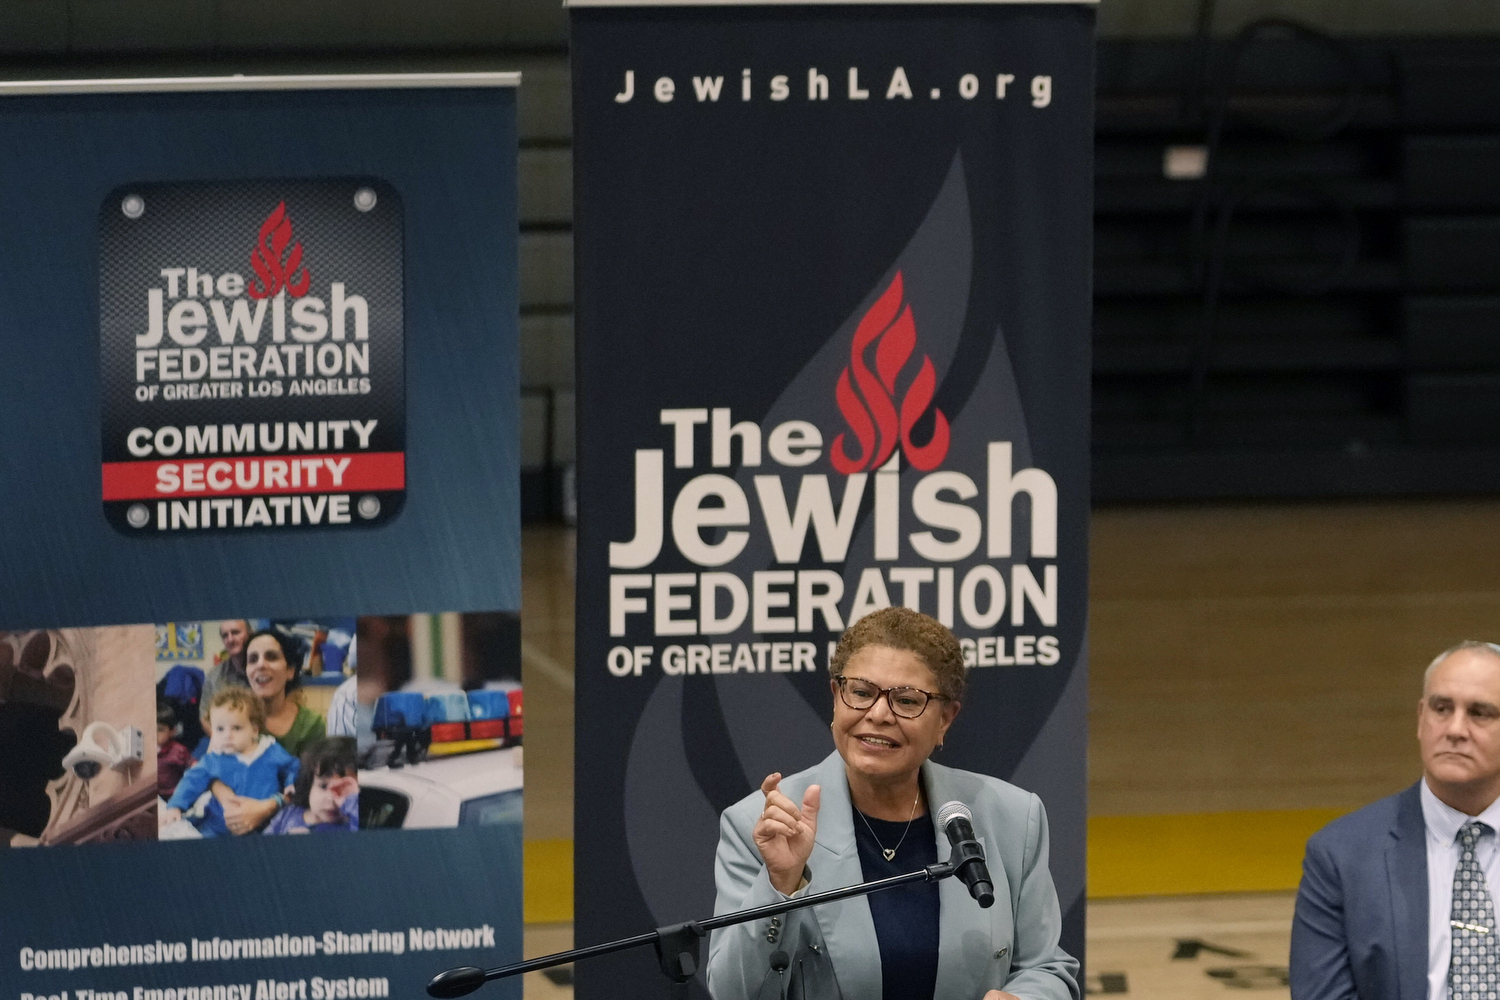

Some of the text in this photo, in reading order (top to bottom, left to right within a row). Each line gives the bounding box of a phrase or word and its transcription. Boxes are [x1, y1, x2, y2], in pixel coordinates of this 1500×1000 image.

[615, 67, 1052, 107] JewishLA.org
[161, 268, 245, 298] The
[136, 282, 368, 348] Jewish
[136, 343, 369, 381] FEDERATION
[135, 377, 371, 402] OF GREATER LOS ANGELES
[127, 420, 378, 456] COMMUNITY
[660, 407, 823, 467] The
[156, 458, 351, 492] SECURITY
[158, 495, 351, 530] INITIATIVE
[609, 441, 1058, 569] Jewish
[609, 564, 1058, 637] FEDERATION
[607, 645, 654, 677] OF
[661, 641, 816, 674] GREATER
[964, 635, 1060, 668] GELES
[20, 925, 495, 971] Comprehensive Information-Sharing Network
